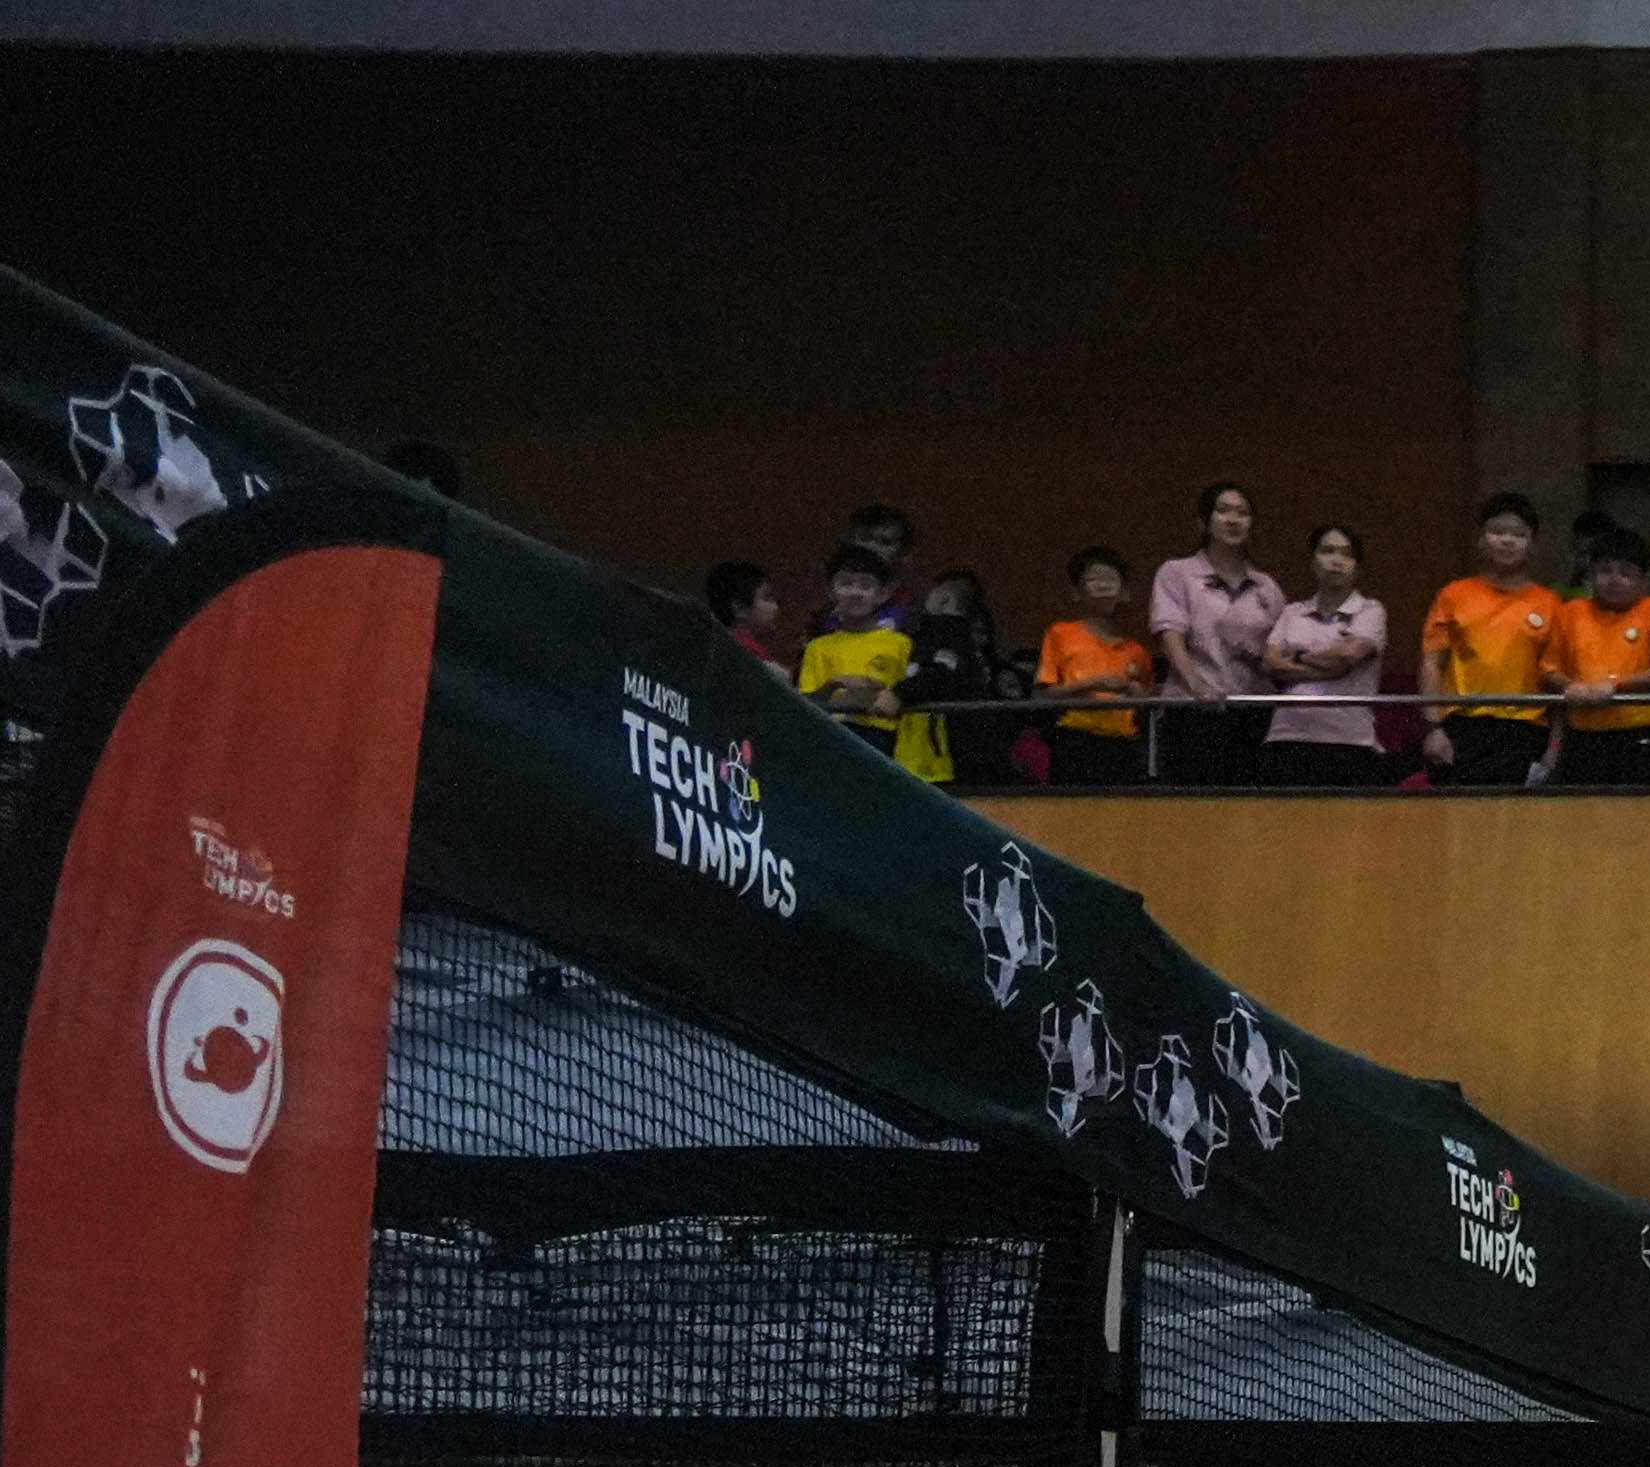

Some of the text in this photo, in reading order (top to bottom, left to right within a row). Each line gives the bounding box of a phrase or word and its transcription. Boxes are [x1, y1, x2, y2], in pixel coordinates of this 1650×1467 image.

[624, 666, 690, 726] MALAYSIA
[622, 709, 719, 813] TECH
[1447, 1162, 1495, 1223] TECH
